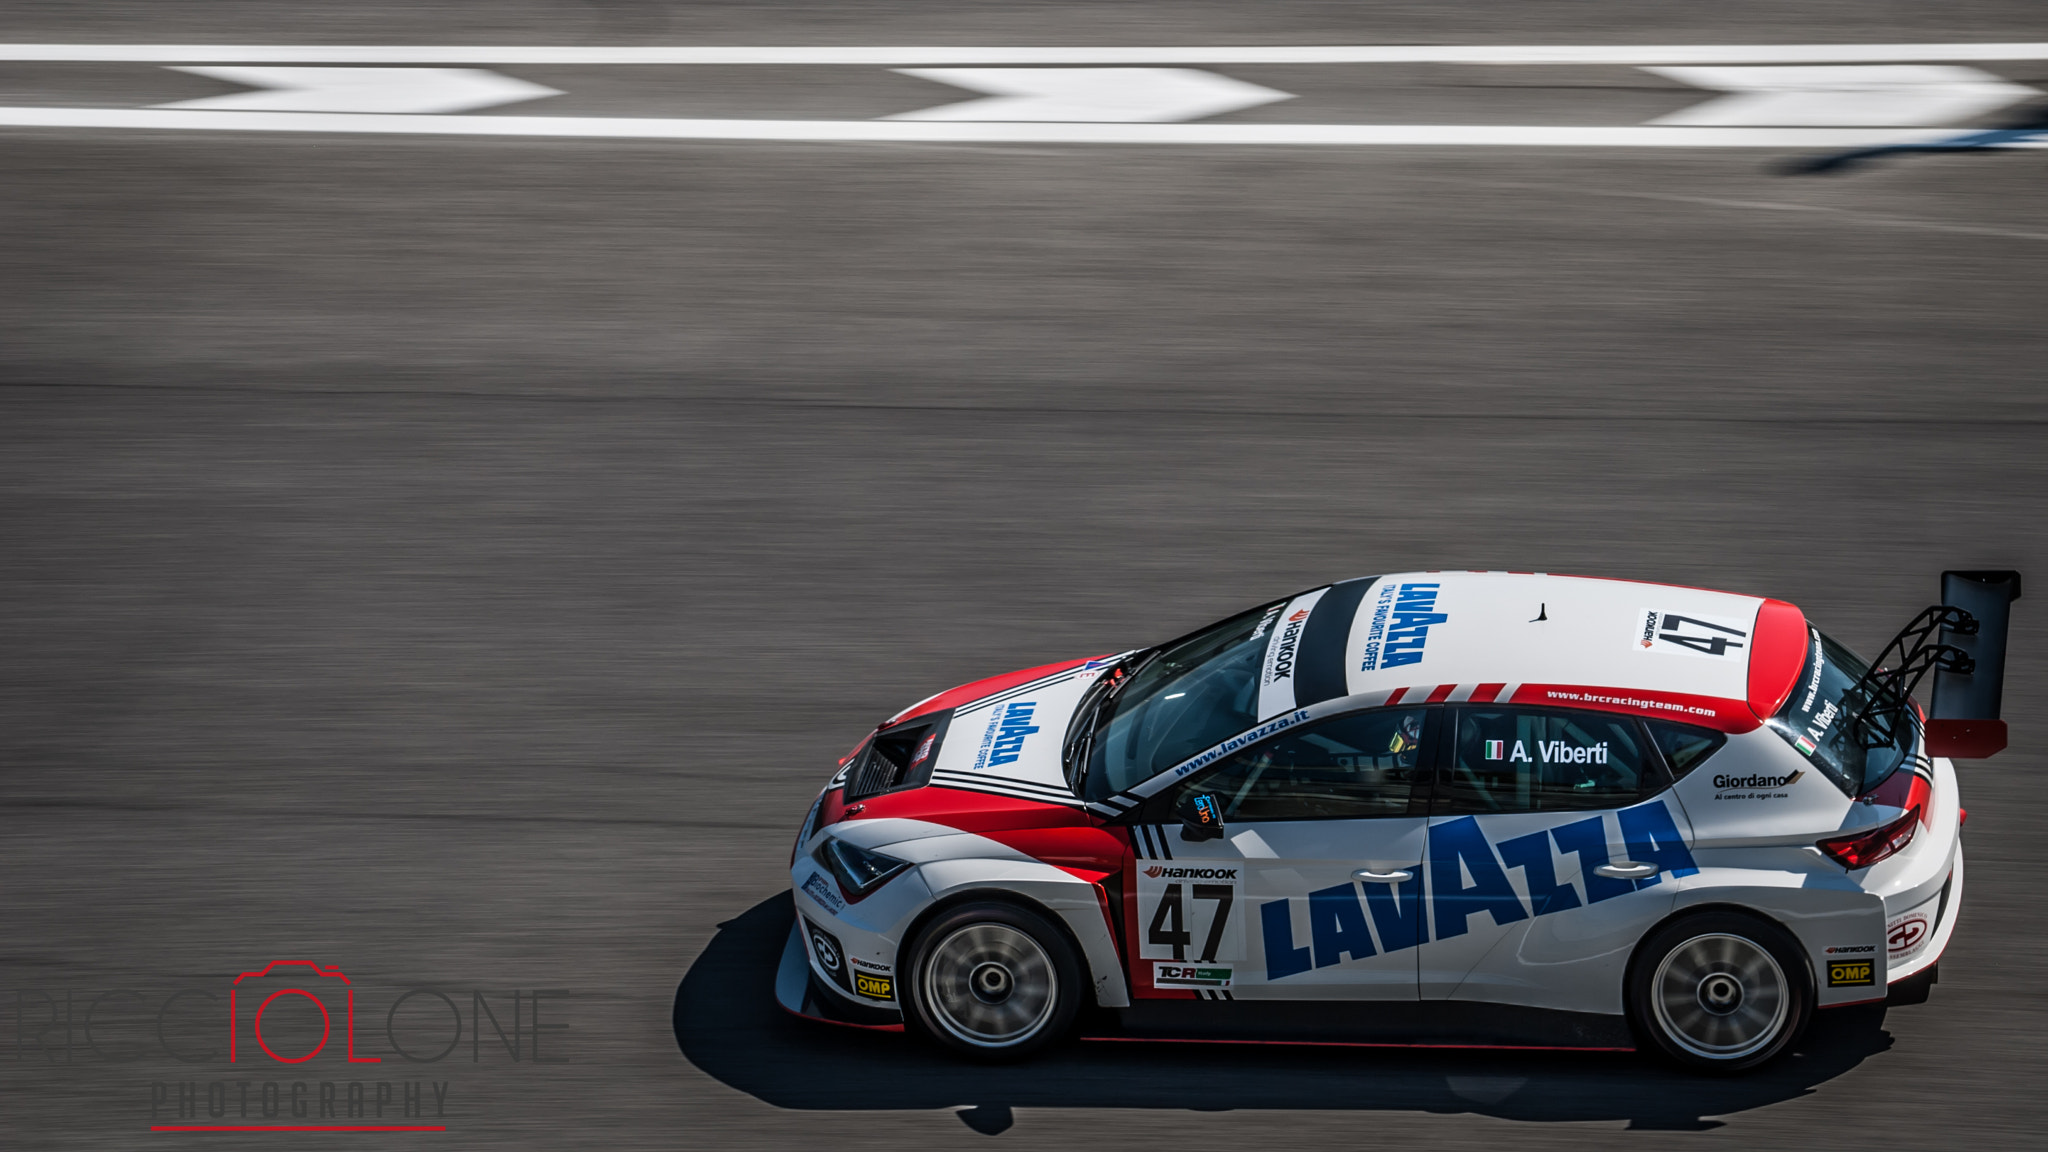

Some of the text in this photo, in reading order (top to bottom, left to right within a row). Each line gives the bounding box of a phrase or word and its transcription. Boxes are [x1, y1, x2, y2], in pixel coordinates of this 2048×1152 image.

[1368, 605, 1390, 641] FAVOURITE
[1381, 583, 1448, 669] LAVAZZA
[1659, 614, 1746, 656] 47
[1361, 641, 1381, 672] COFFEE
[1547, 690, 1716, 717] www.brcracingteam.com
[986, 701, 1040, 768] LAVAZZA
[1807, 699, 1839, 742] A. Viberti
[1175, 709, 1311, 776] www.lavazza.it
[1509, 740, 1608, 764] A. Viberti
[1713, 773, 1786, 788] Giordano
[1756, 792, 1771, 800] ogni
[1260, 799, 1701, 981] LAVAZZA
[1148, 883, 1234, 961] 47
[858, 978, 890, 994] OMP
[1159, 966, 1196, 978] TCR
[1831, 966, 1871, 980] OMP
